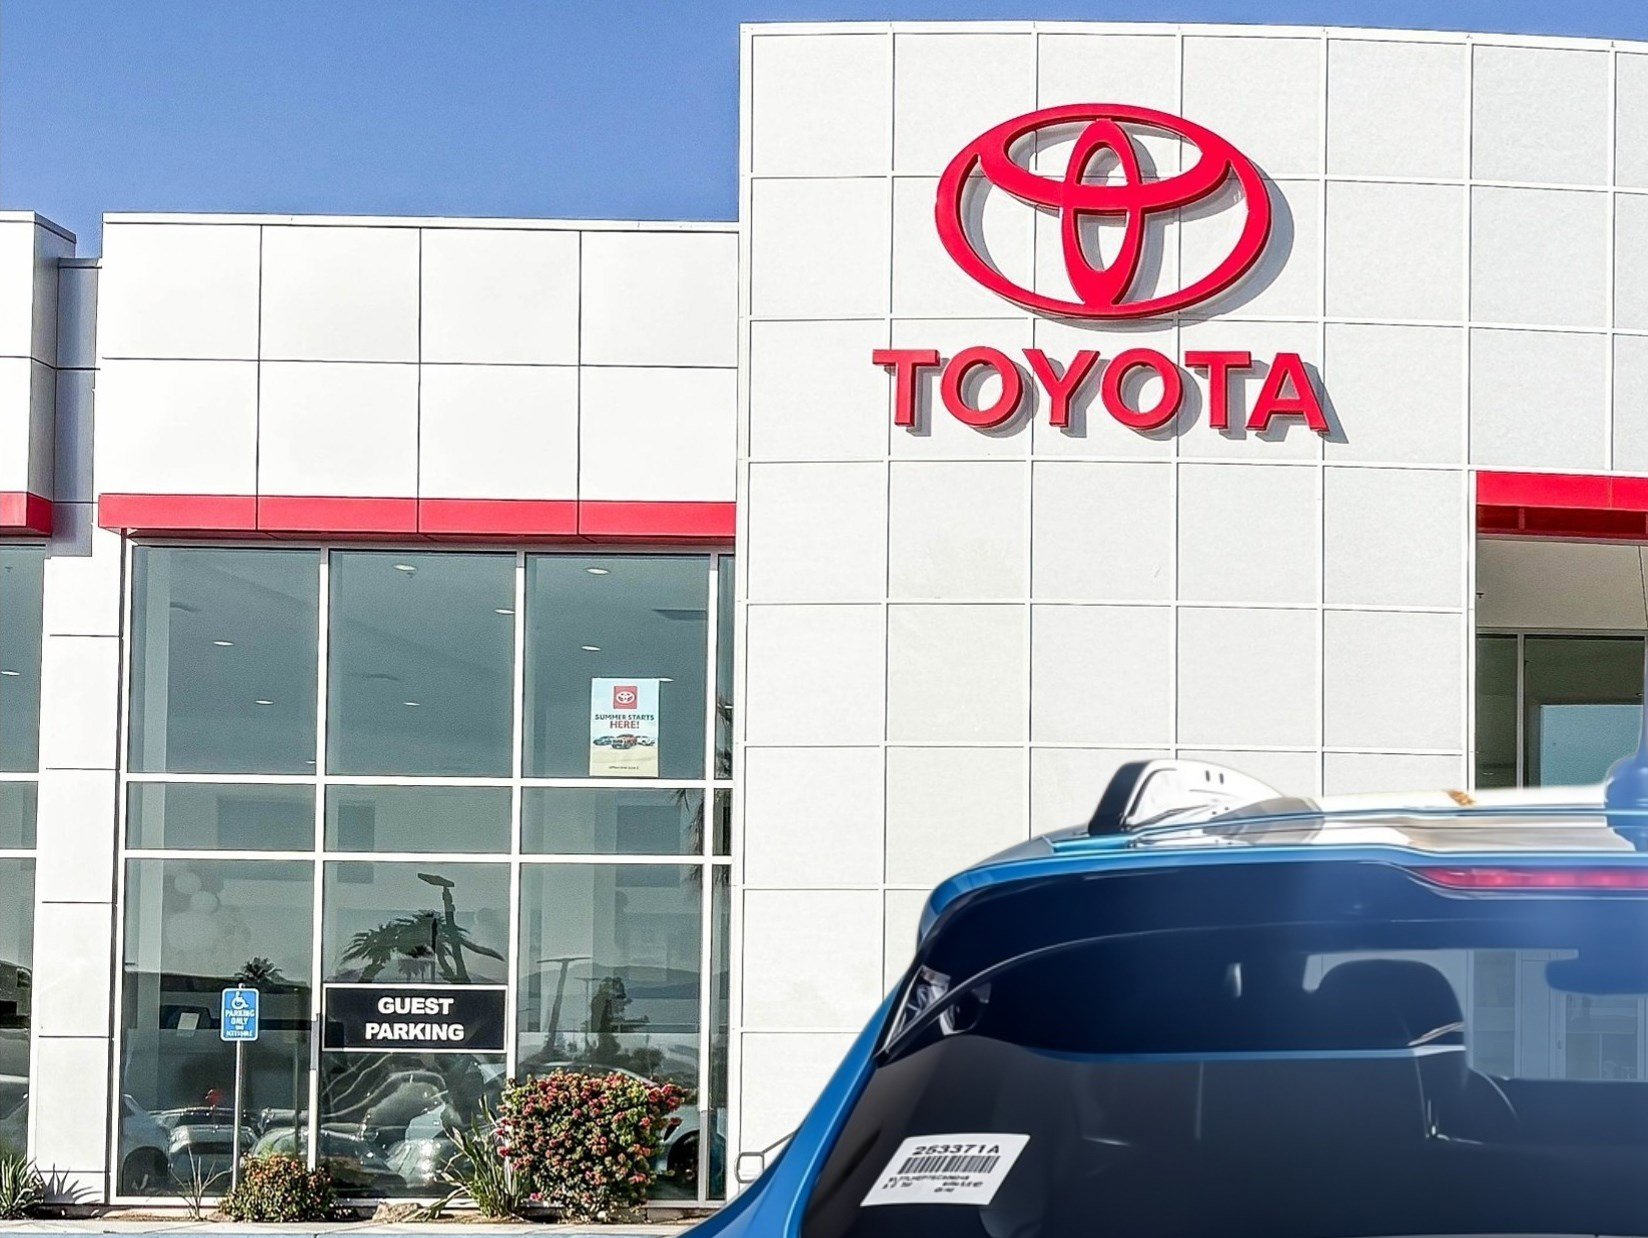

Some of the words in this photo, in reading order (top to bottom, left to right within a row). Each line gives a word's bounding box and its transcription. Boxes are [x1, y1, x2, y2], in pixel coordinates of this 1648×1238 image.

[872, 346, 1328, 432] TOYOTA
[609, 721, 640, 729] HERE!
[377, 997, 454, 1015] GUEST
[365, 1022, 465, 1041] PARKING
[912, 1144, 1001, 1156] 253371A
